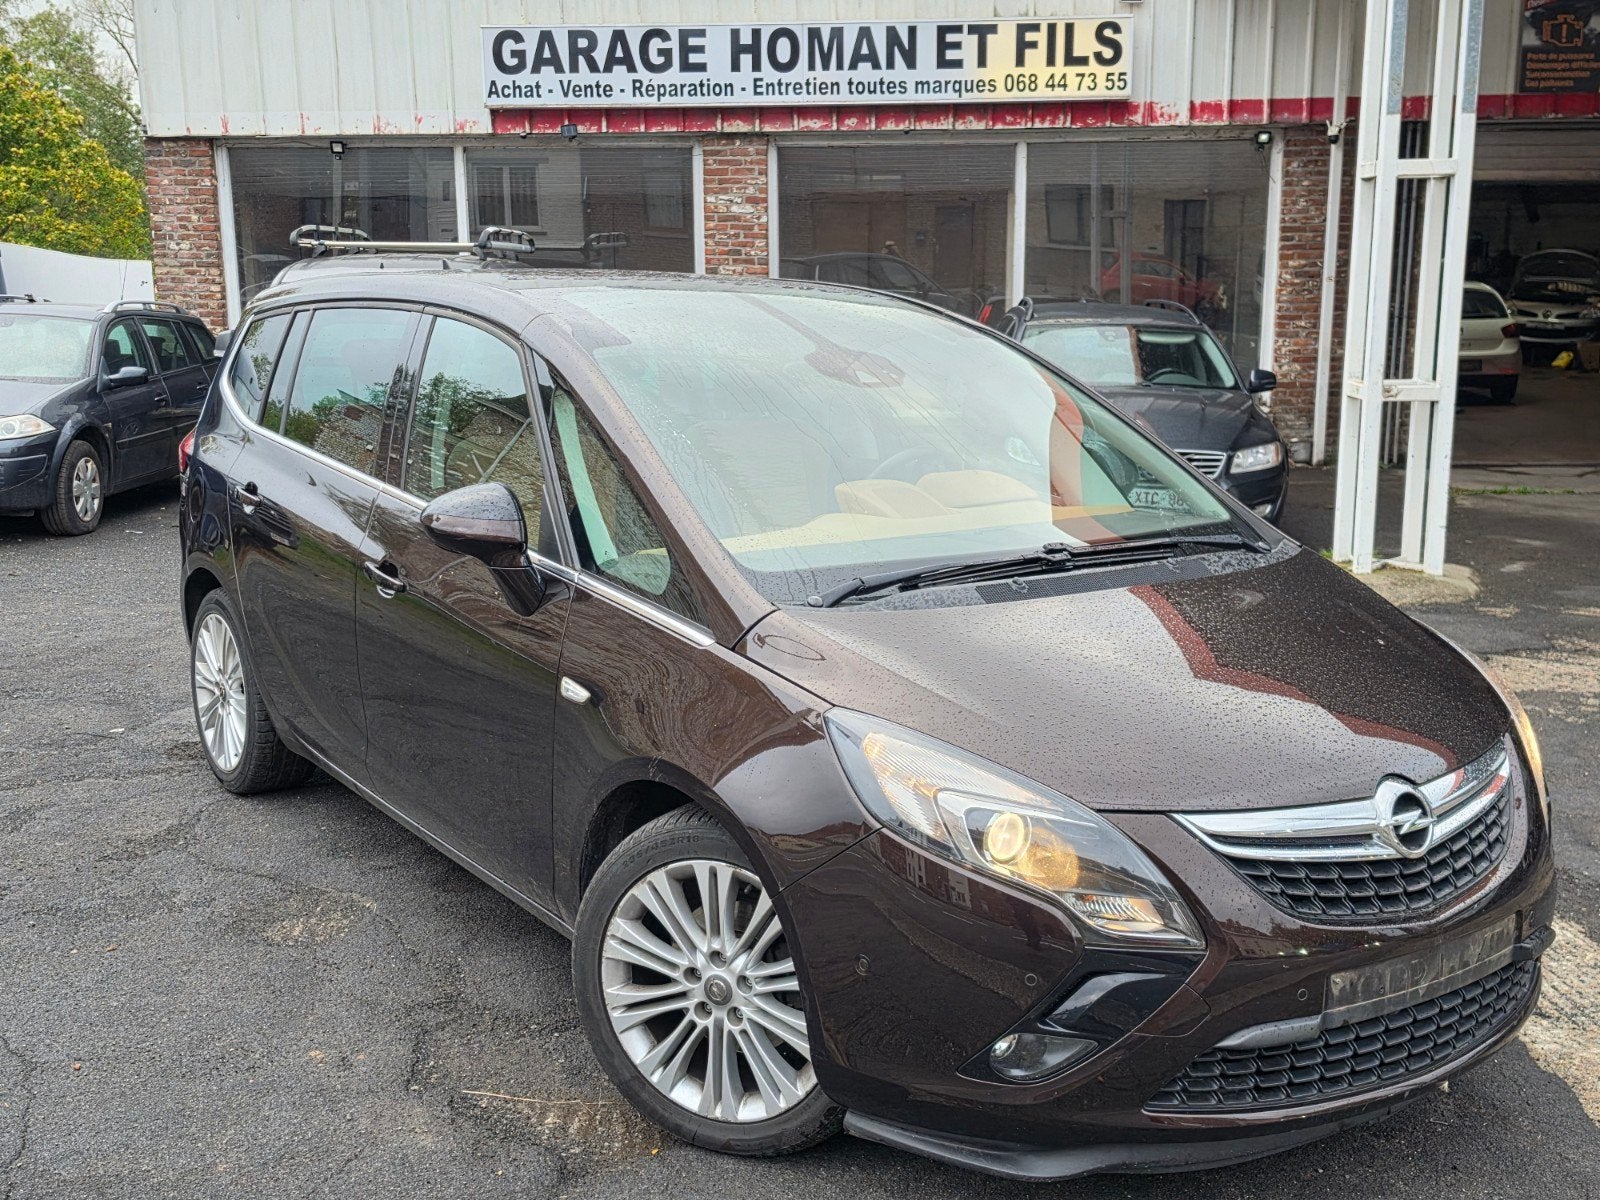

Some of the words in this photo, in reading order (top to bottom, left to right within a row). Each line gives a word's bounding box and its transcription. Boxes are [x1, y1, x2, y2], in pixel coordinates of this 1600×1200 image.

[491, 27, 708, 76] GARAGE
[730, 26, 918, 74] HOMAN
[936, 24, 999, 70] ET
[1015, 21, 1123, 68] FILS
[487, 80, 542, 99] Achat
[558, 80, 614, 99] Vente
[631, 79, 734, 103] Réparation
[753, 77, 841, 96] Entretien
[847, 77, 908, 96] toutes
[914, 79, 997, 99] marques
[1004, 74, 1038, 93] 068
[1045, 73, 1068, 92] 44
[1075, 73, 1098, 91] 73
[1105, 72, 1128, 91] 55
[1135, 490, 1159, 505] XTC
